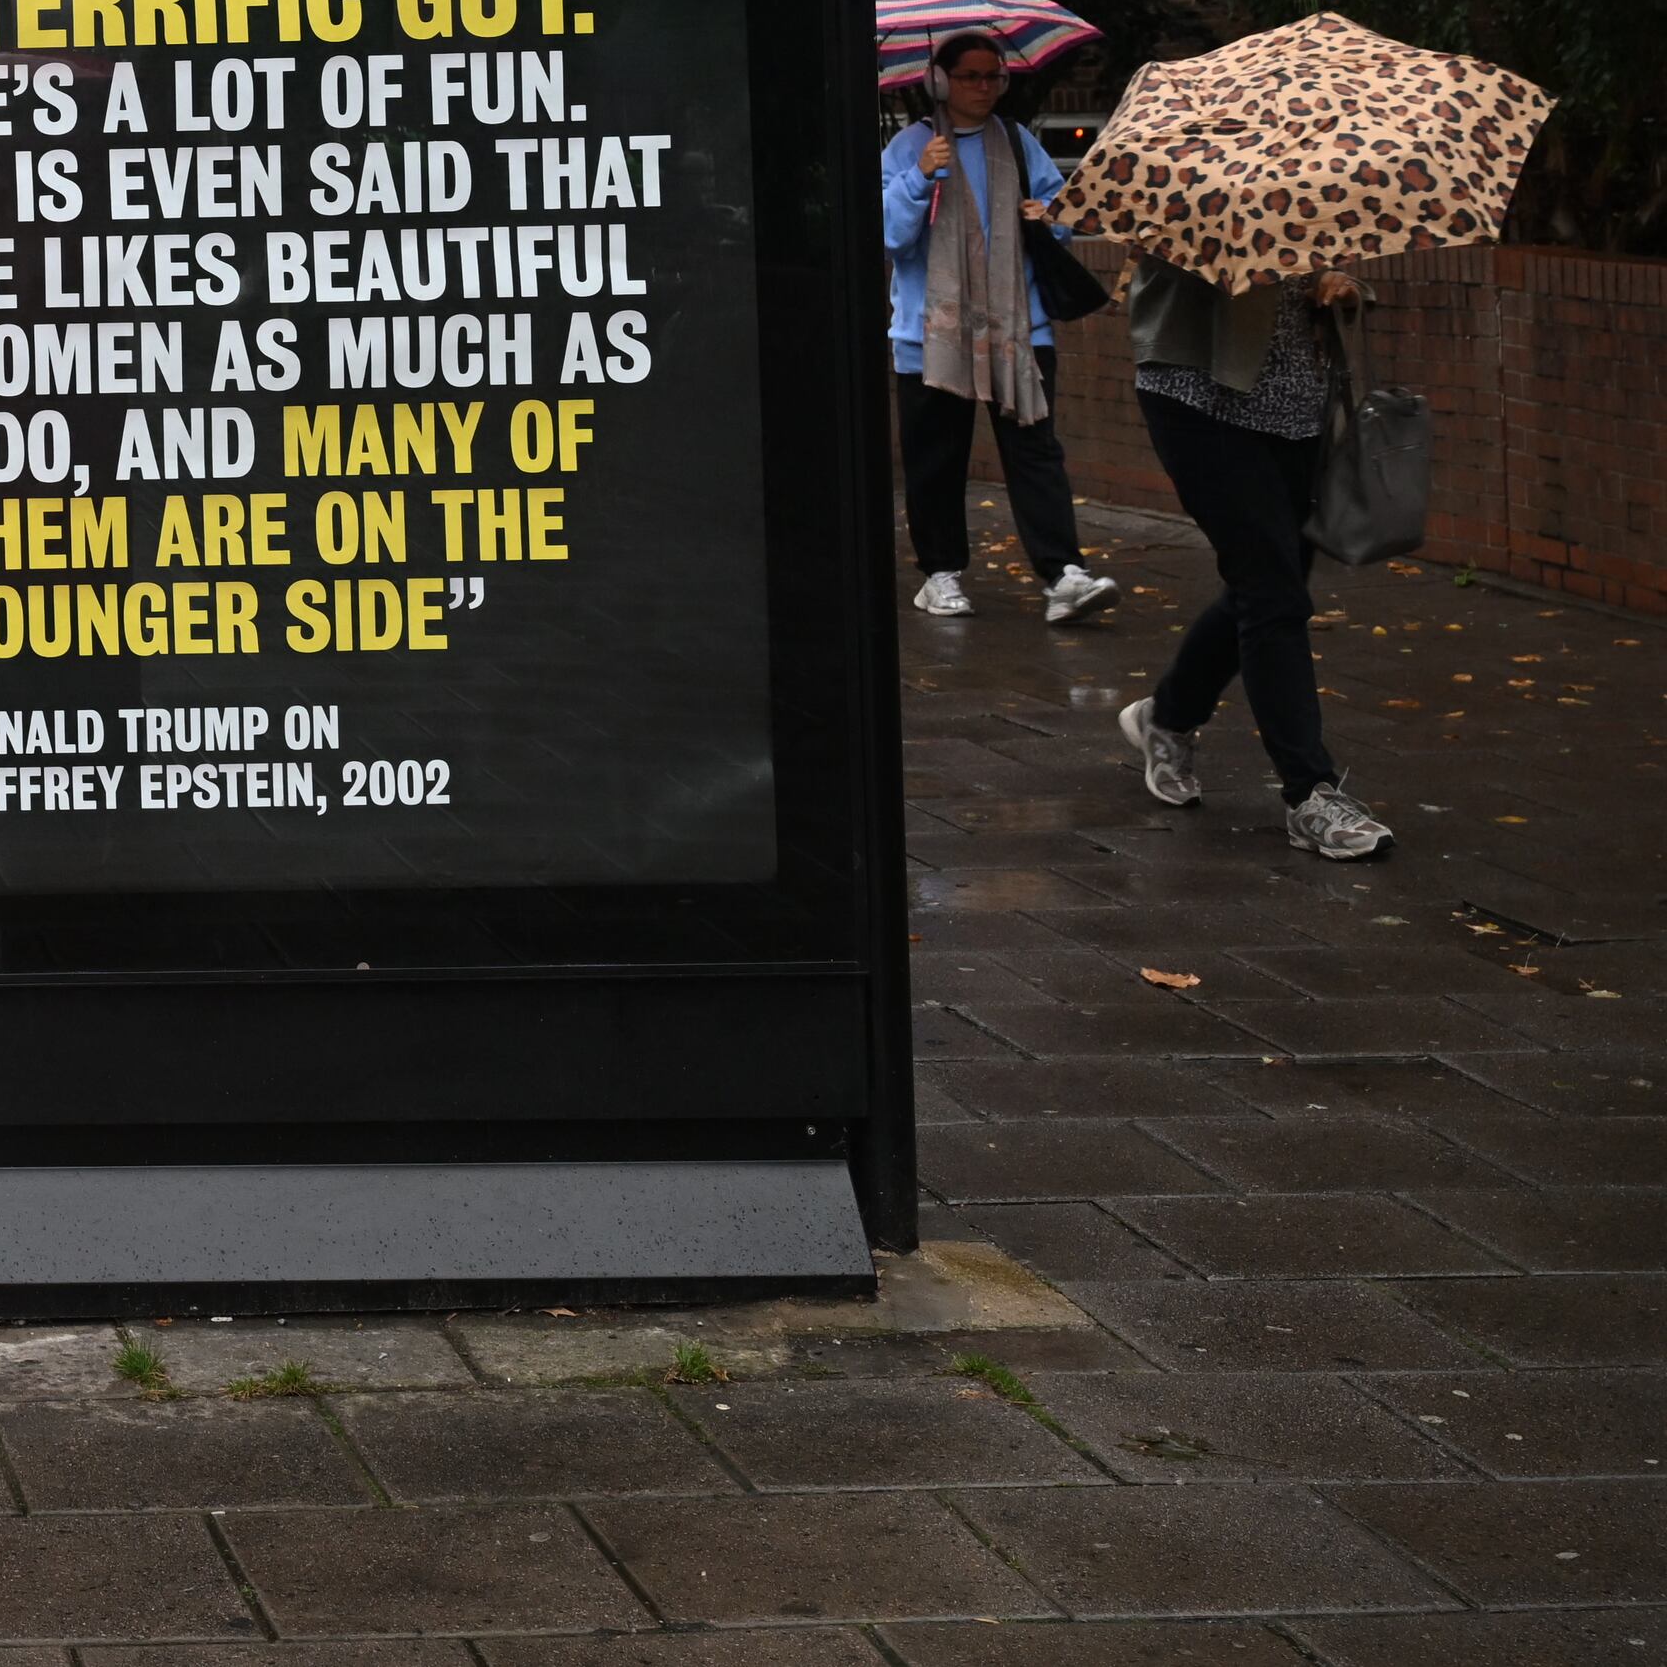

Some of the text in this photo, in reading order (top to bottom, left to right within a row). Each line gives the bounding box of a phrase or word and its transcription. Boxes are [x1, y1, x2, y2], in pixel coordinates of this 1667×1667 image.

[103, 61, 149, 134] A
[174, 57, 296, 132] LOT
[320, 54, 404, 129] OF
[430, 50, 587, 125] FUN.
[15, 149, 83, 223] IS
[108, 144, 283, 220] EVEN
[309, 140, 472, 216] SAID
[495, 134, 672, 211] THAT
[44, 232, 241, 308] LIKES
[266, 223, 647, 304] BEAUTIFUL
[210, 318, 301, 392] AS
[328, 313, 533, 389] MUCH
[560, 309, 652, 384] AS
[115, 407, 256, 481] AND
[283, 400, 485, 477] MANY
[510, 399, 595, 474] OF
[155, 493, 291, 567] ARE
[315, 490, 407, 565] ON
[431, 487, 569, 562] THE
[285, 577, 485, 654] SIDE”
[118, 706, 269, 753] TRUMP
[284, 705, 340, 751] ON
[140, 762, 328, 816] EPSTEIN,
[342, 759, 450, 806] 2002
